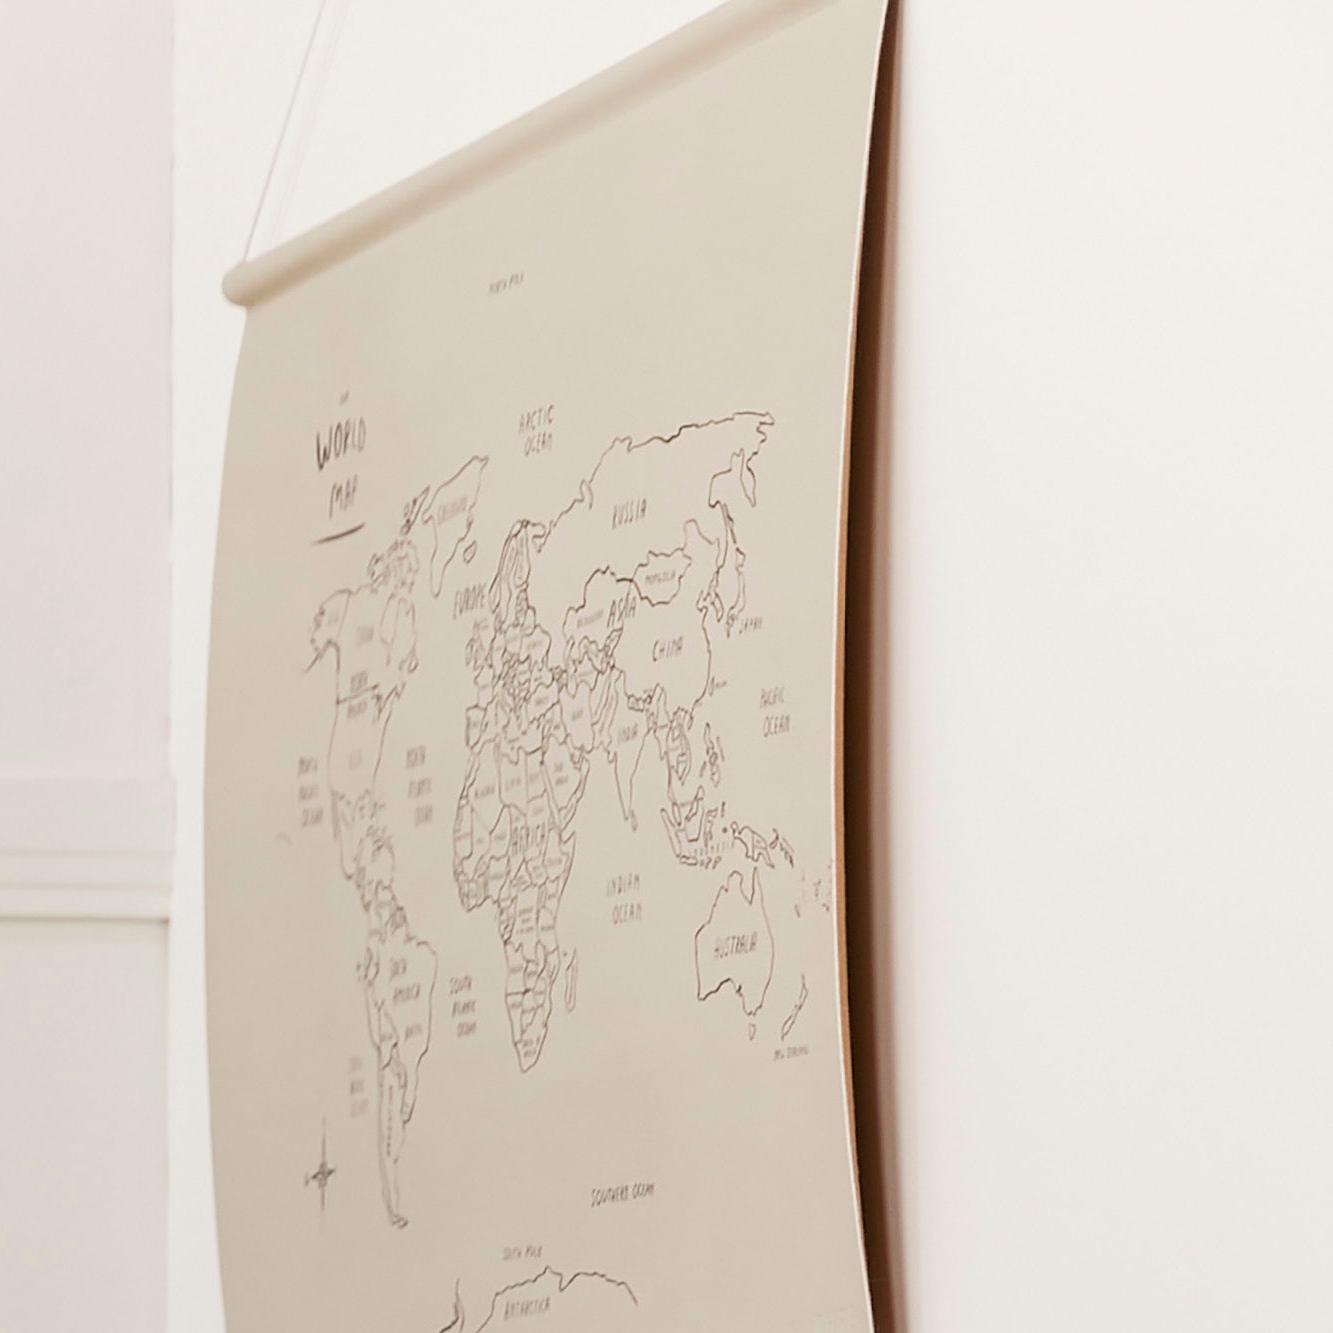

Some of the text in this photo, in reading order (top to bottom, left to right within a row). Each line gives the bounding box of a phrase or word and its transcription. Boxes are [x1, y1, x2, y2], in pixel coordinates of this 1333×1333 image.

[518, 404, 554, 435] ARCTIC
[316, 416, 366, 472] WORLD
[524, 431, 553, 457] OCEAN
[329, 474, 358, 520] MAP
[611, 498, 647, 530] RUSSIA
[606, 595, 637, 629] ASIA
[652, 636, 684, 662] CHINA
[762, 714, 791, 738] OCEAN
[612, 902, 642, 926] OCEAN
[714, 931, 758, 959] AUSTRALIA
